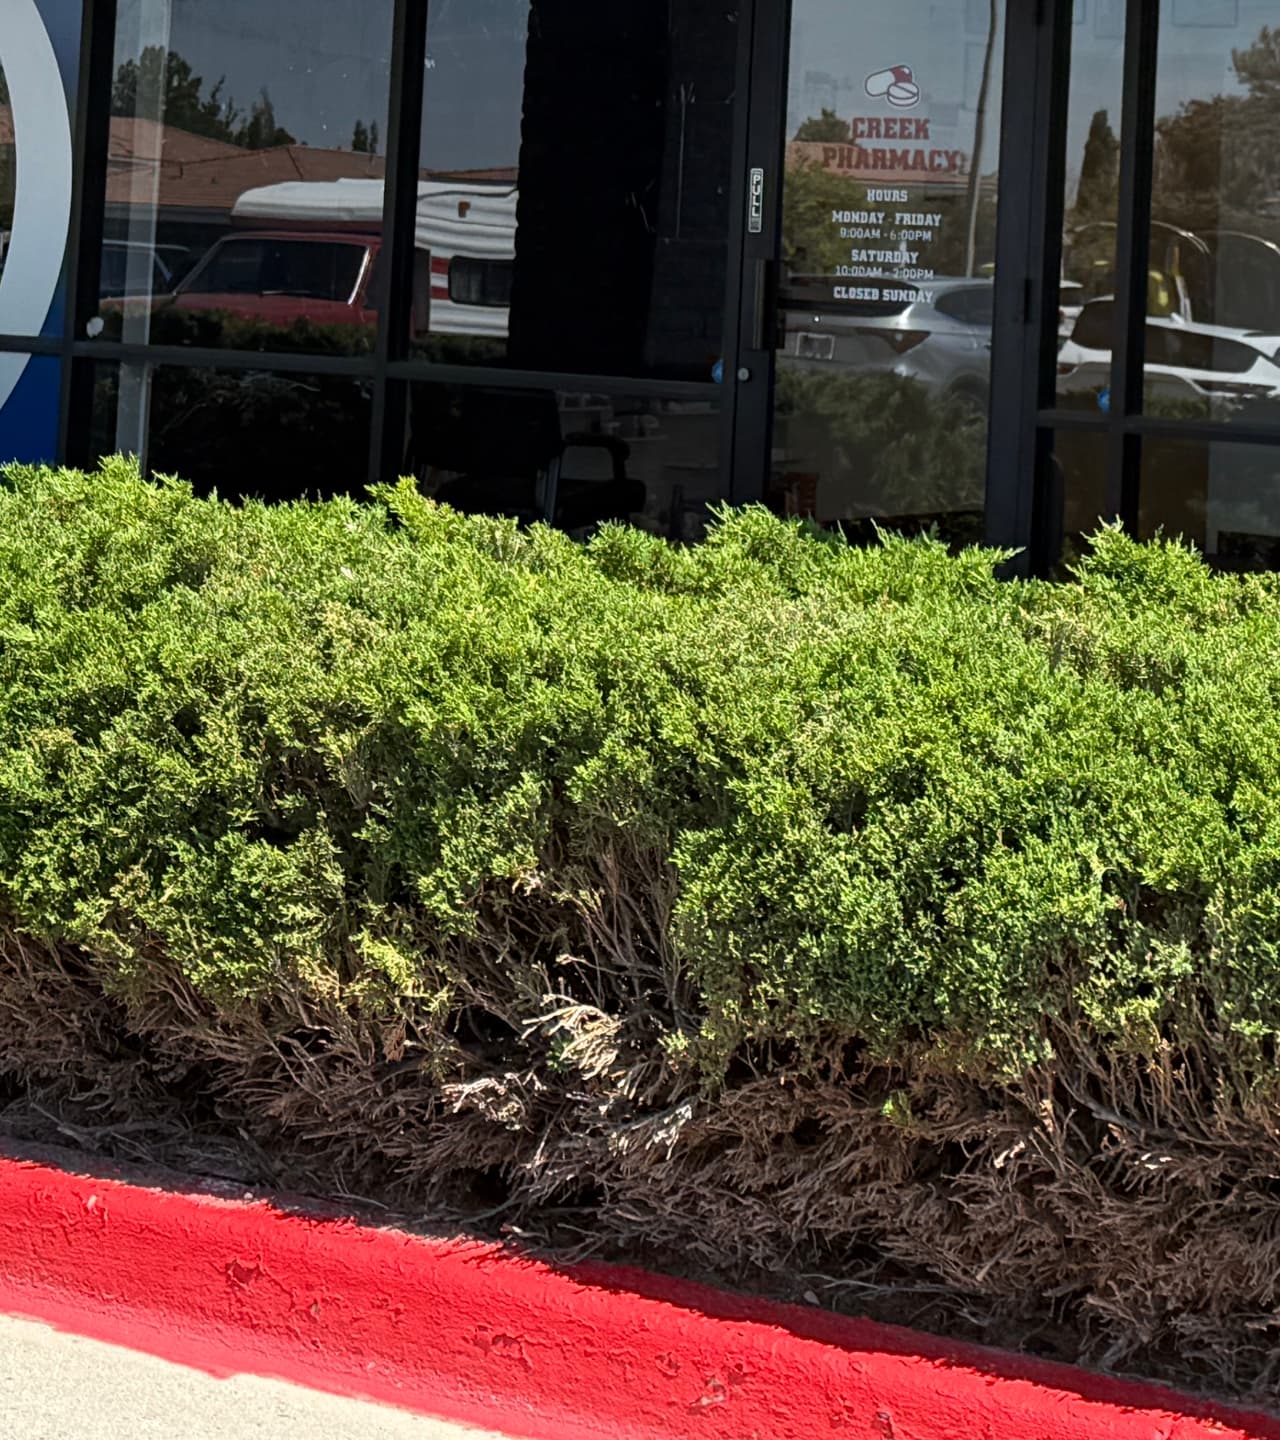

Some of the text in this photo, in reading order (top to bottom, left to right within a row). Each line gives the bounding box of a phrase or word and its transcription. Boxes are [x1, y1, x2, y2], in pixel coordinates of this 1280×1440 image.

[852, 116, 930, 140] CREEK
[822, 145, 960, 172] PHARMACY
[751, 174, 761, 217] PULL
[866, 188, 909, 202] HOURS
[831, 209, 885, 225] MONDAY
[894, 212, 942, 227] FRIDAY
[889, 229, 933, 242] 6:00PM
[851, 248, 920, 265] SATURDAY
[835, 265, 883, 278] 10:00AM
[832, 286, 934, 304] CLOSED SUNDAY
